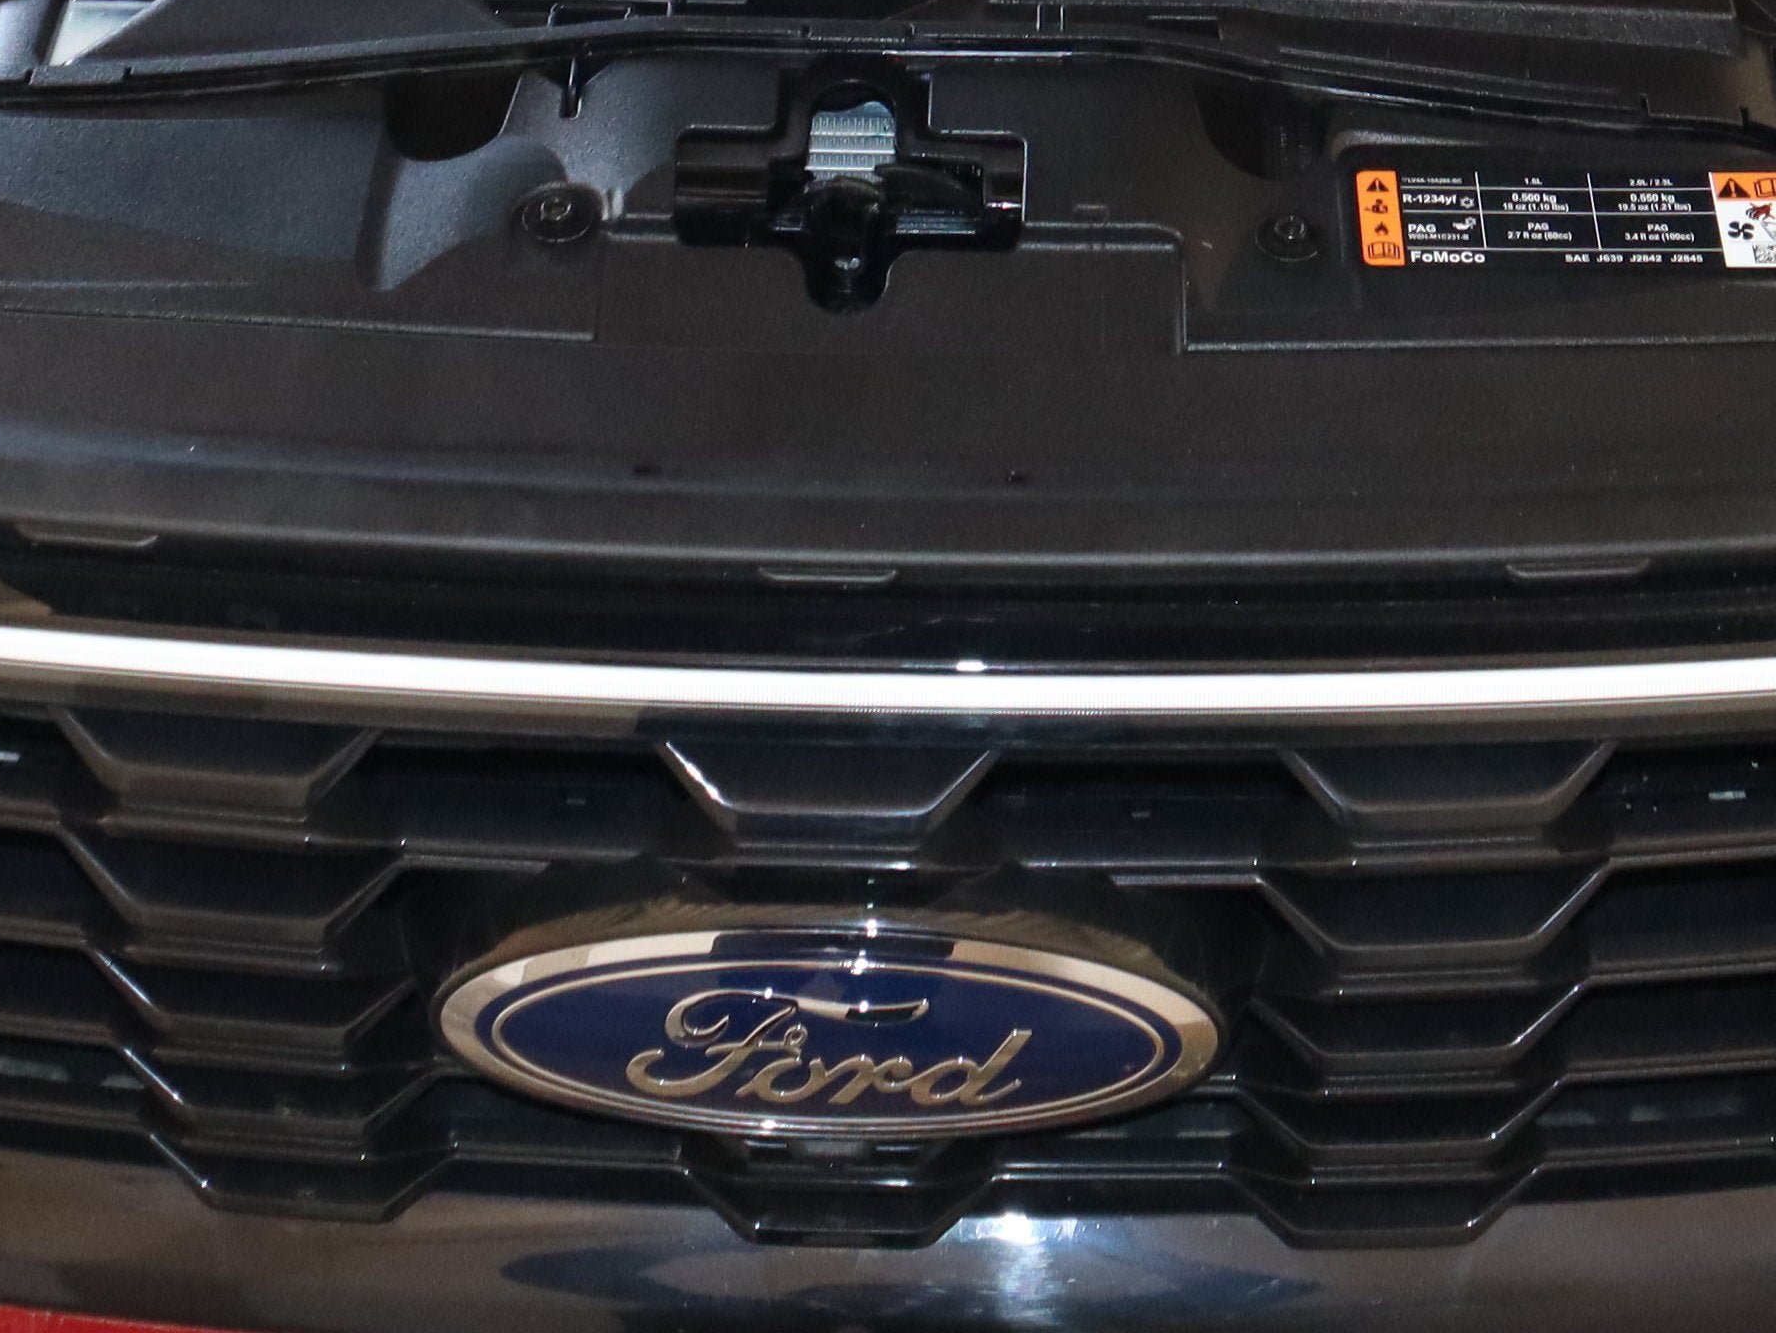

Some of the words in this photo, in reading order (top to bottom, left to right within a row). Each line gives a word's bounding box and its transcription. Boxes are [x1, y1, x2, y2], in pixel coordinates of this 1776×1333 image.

[1402, 193, 1457, 206] R-1234yf
[1542, 192, 1557, 204] kg
[1661, 193, 1675, 204] kg
[1408, 223, 1437, 233] PAG
[1527, 222, 1550, 231] PAG
[1647, 223, 1669, 232] PAG
[1410, 251, 1486, 263] FoMoCo
[1564, 254, 1590, 263] SAE
[1596, 254, 1623, 263] J639
[626, 987, 1033, 1106] Ford
